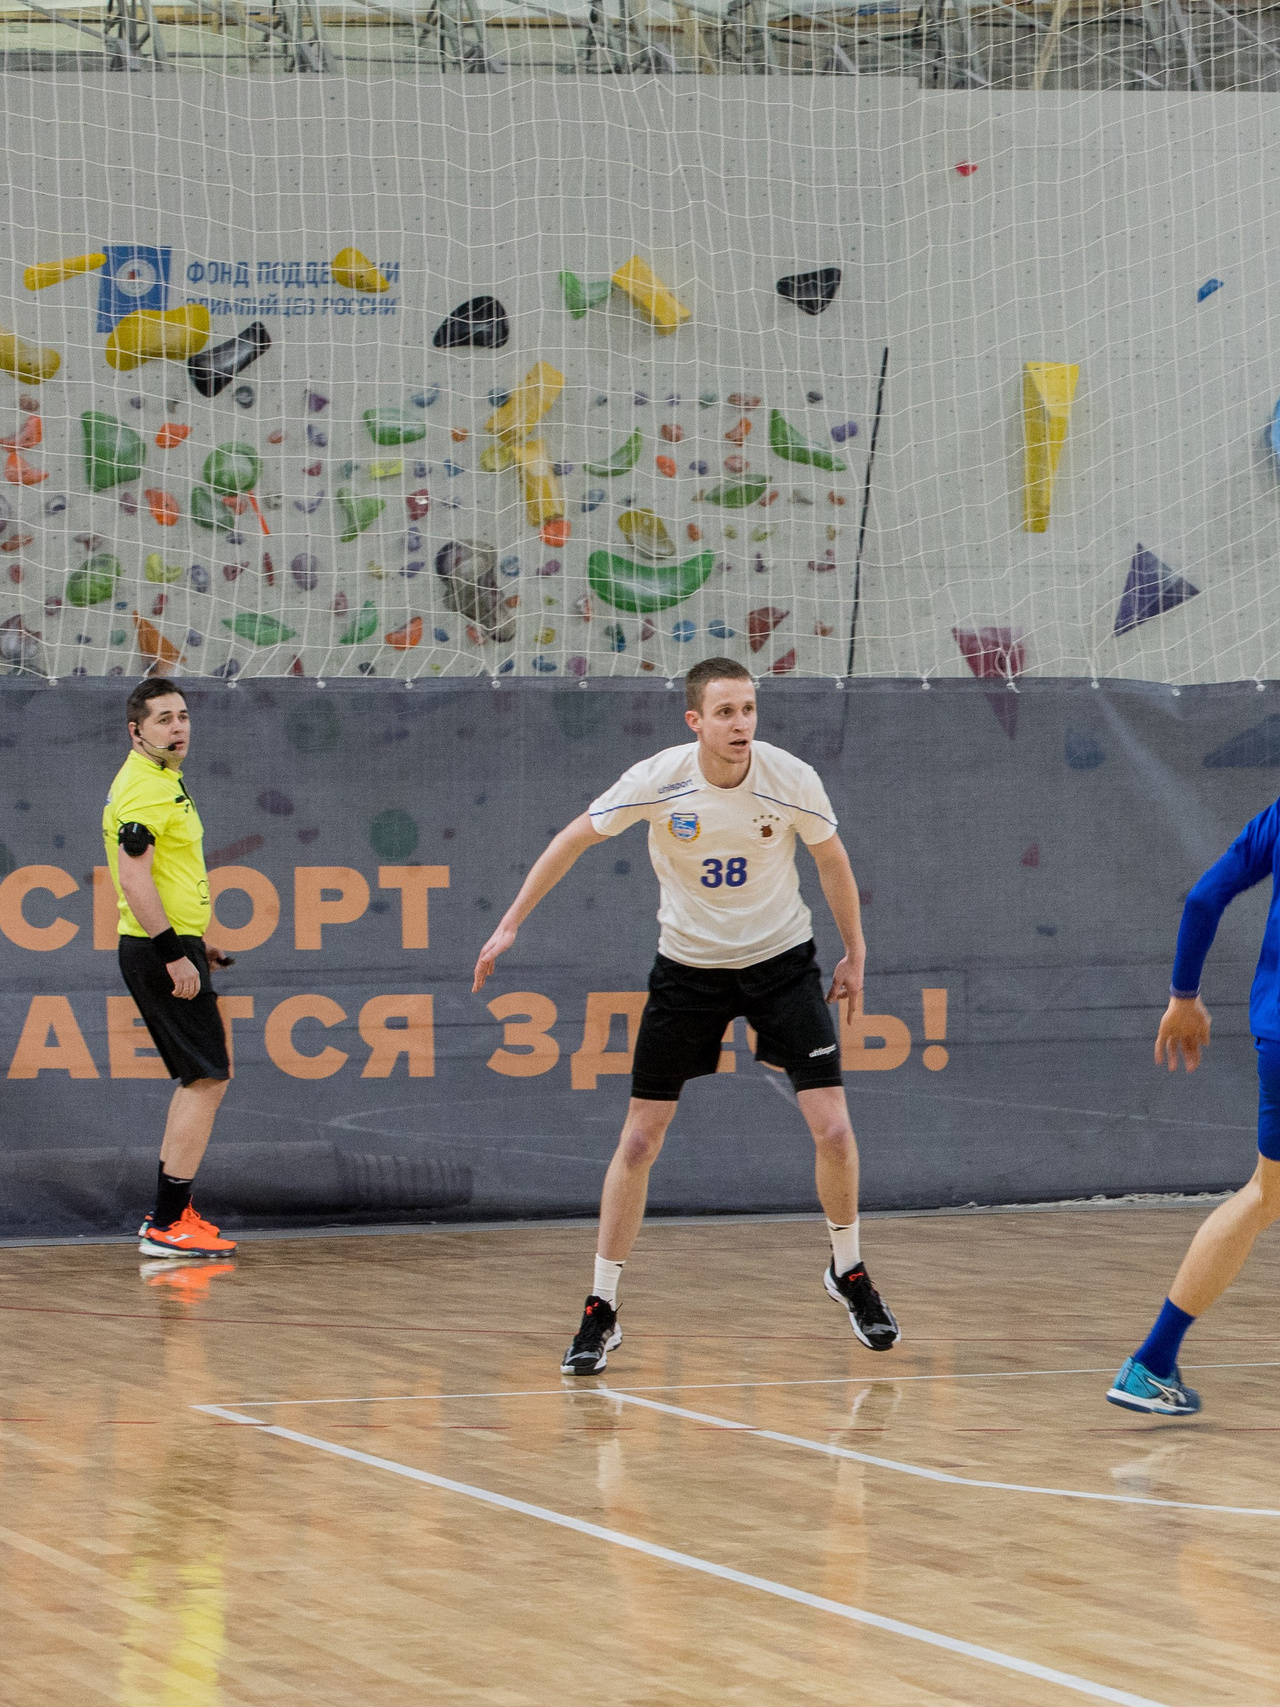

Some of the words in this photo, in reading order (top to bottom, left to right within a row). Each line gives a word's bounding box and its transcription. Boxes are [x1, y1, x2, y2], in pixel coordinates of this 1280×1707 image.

[186, 261, 249, 288] ФОНД
[256, 261, 400, 288] ПОДДЕИ
[700, 857, 747, 888] 38
[486, 988, 949, 1090] ЗДЬ!
